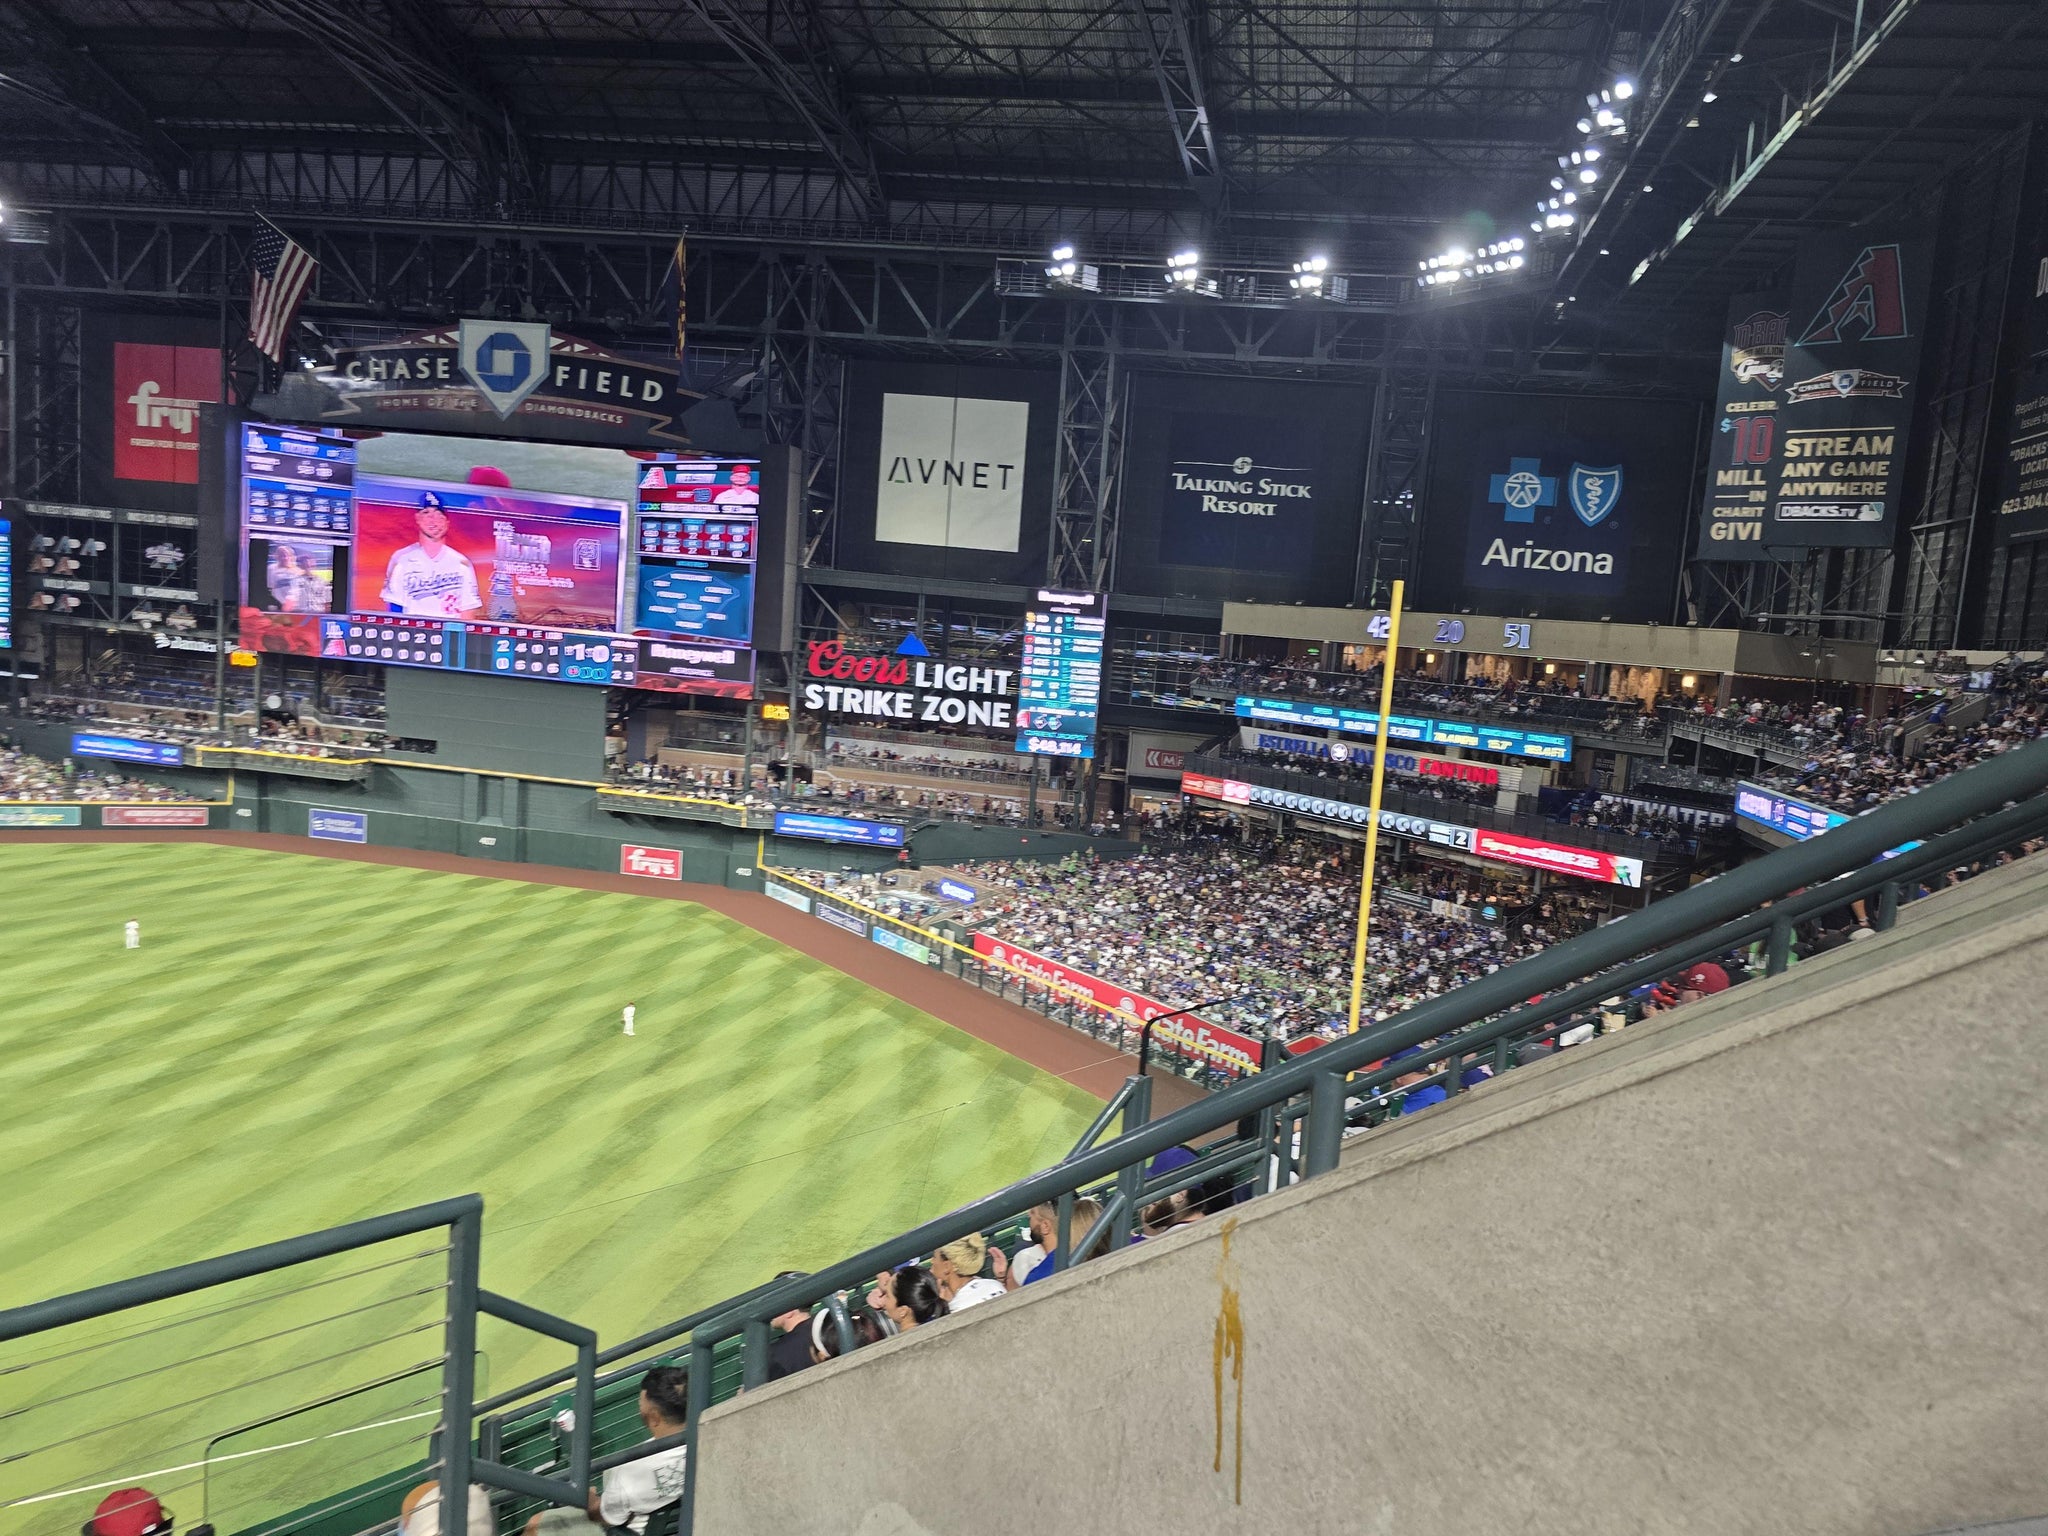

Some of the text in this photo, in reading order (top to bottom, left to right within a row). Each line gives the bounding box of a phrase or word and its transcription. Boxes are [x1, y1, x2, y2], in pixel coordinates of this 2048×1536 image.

[344, 356, 664, 402] CHASE FIELD
[1861, 379, 1894, 389] FIELD
[383, 398, 624, 425] HOME OF THE DIAMONDBACKS
[1720, 415, 1777, 466] $10
[1783, 435, 1896, 458] STREAM
[888, 456, 1014, 490] AVNET
[1716, 469, 1767, 487] MILL
[1780, 460, 1890, 478] ANY GAME
[1171, 473, 1312, 499] TALKING STICK
[1778, 481, 1887, 497] ANYWHERE
[1201, 494, 1278, 517] RESORT
[1481, 538, 1614, 575] Arizona
[1366, 615, 1531, 650] 42 20 51
[808, 640, 1013, 695] Coors LIGHT
[804, 684, 914, 719] STRIKE
[920, 696, 1012, 728] ZONE
[1419, 757, 1499, 785] CANTINA
[1011, 953, 1094, 1007] State Farm
[1197, 1026, 1254, 1077] Farm
